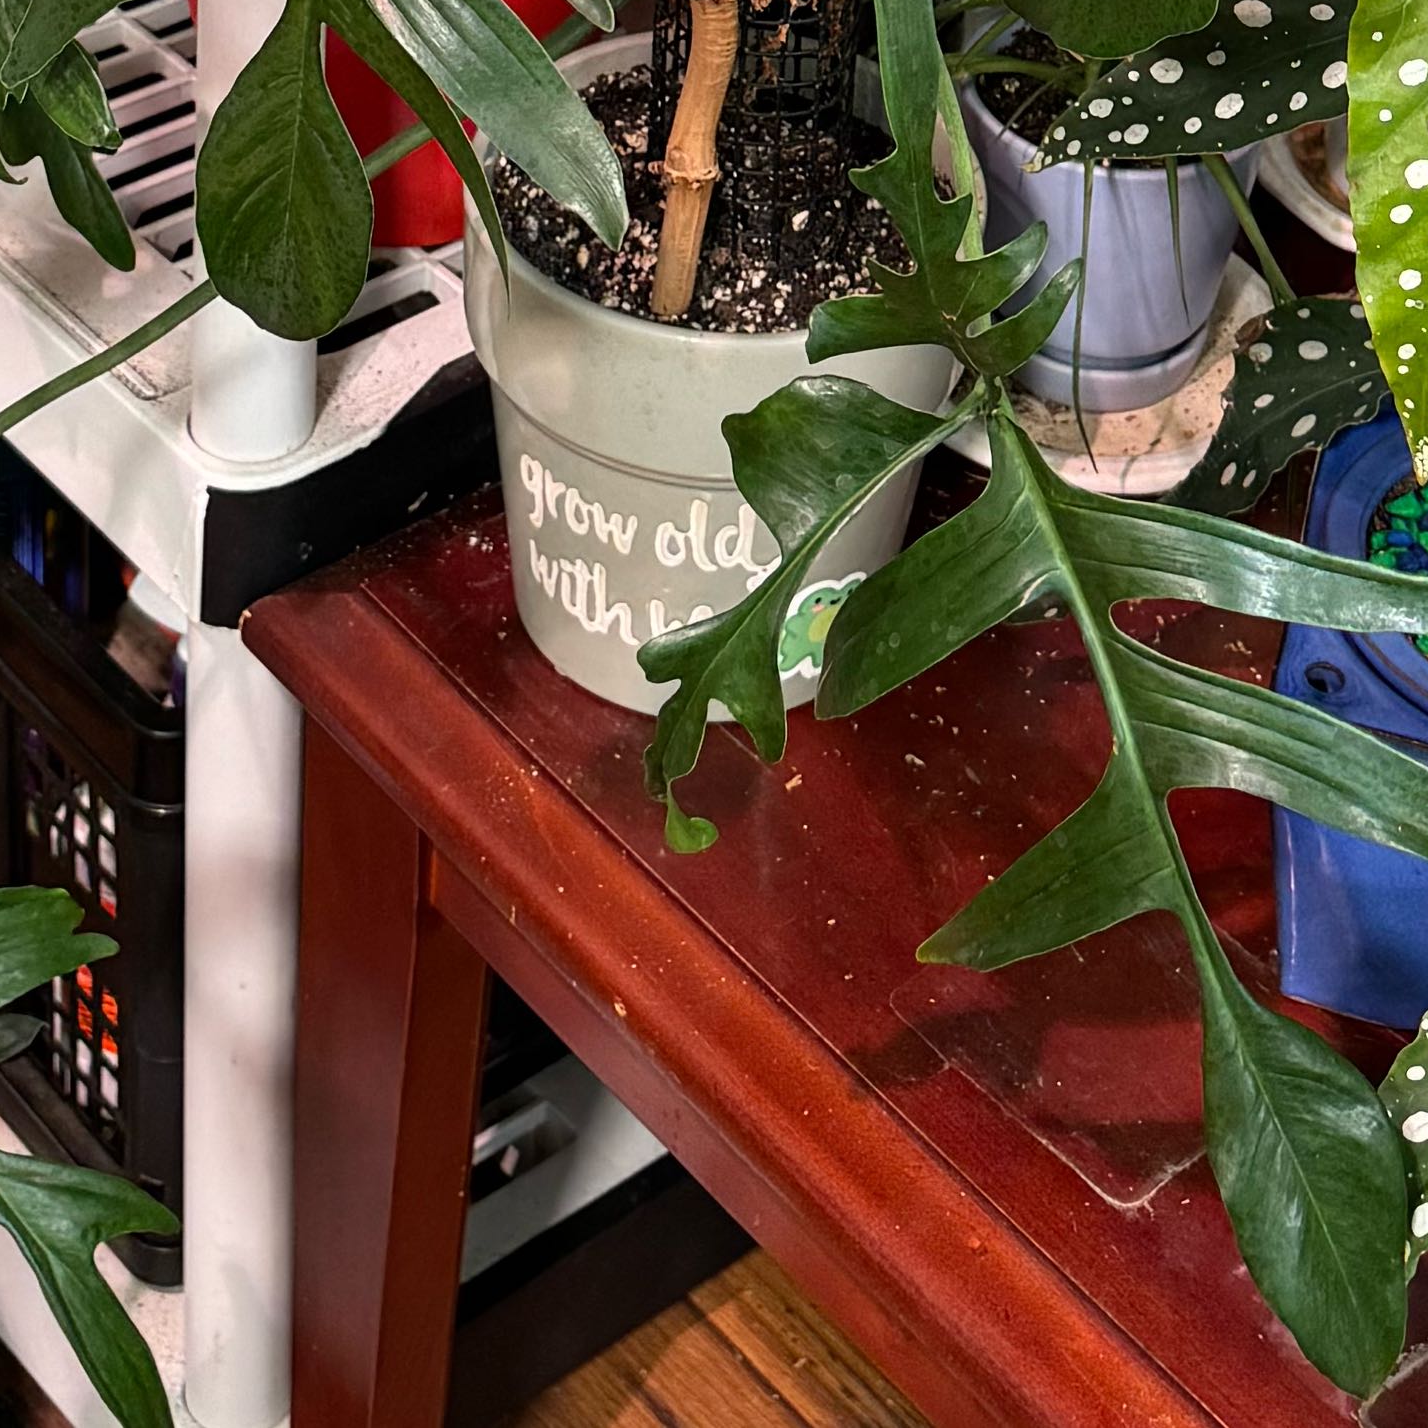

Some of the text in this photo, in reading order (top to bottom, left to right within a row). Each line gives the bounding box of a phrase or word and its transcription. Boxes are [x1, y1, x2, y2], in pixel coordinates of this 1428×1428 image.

[519, 453, 782, 573] grow old
[529, 538, 643, 646] with
